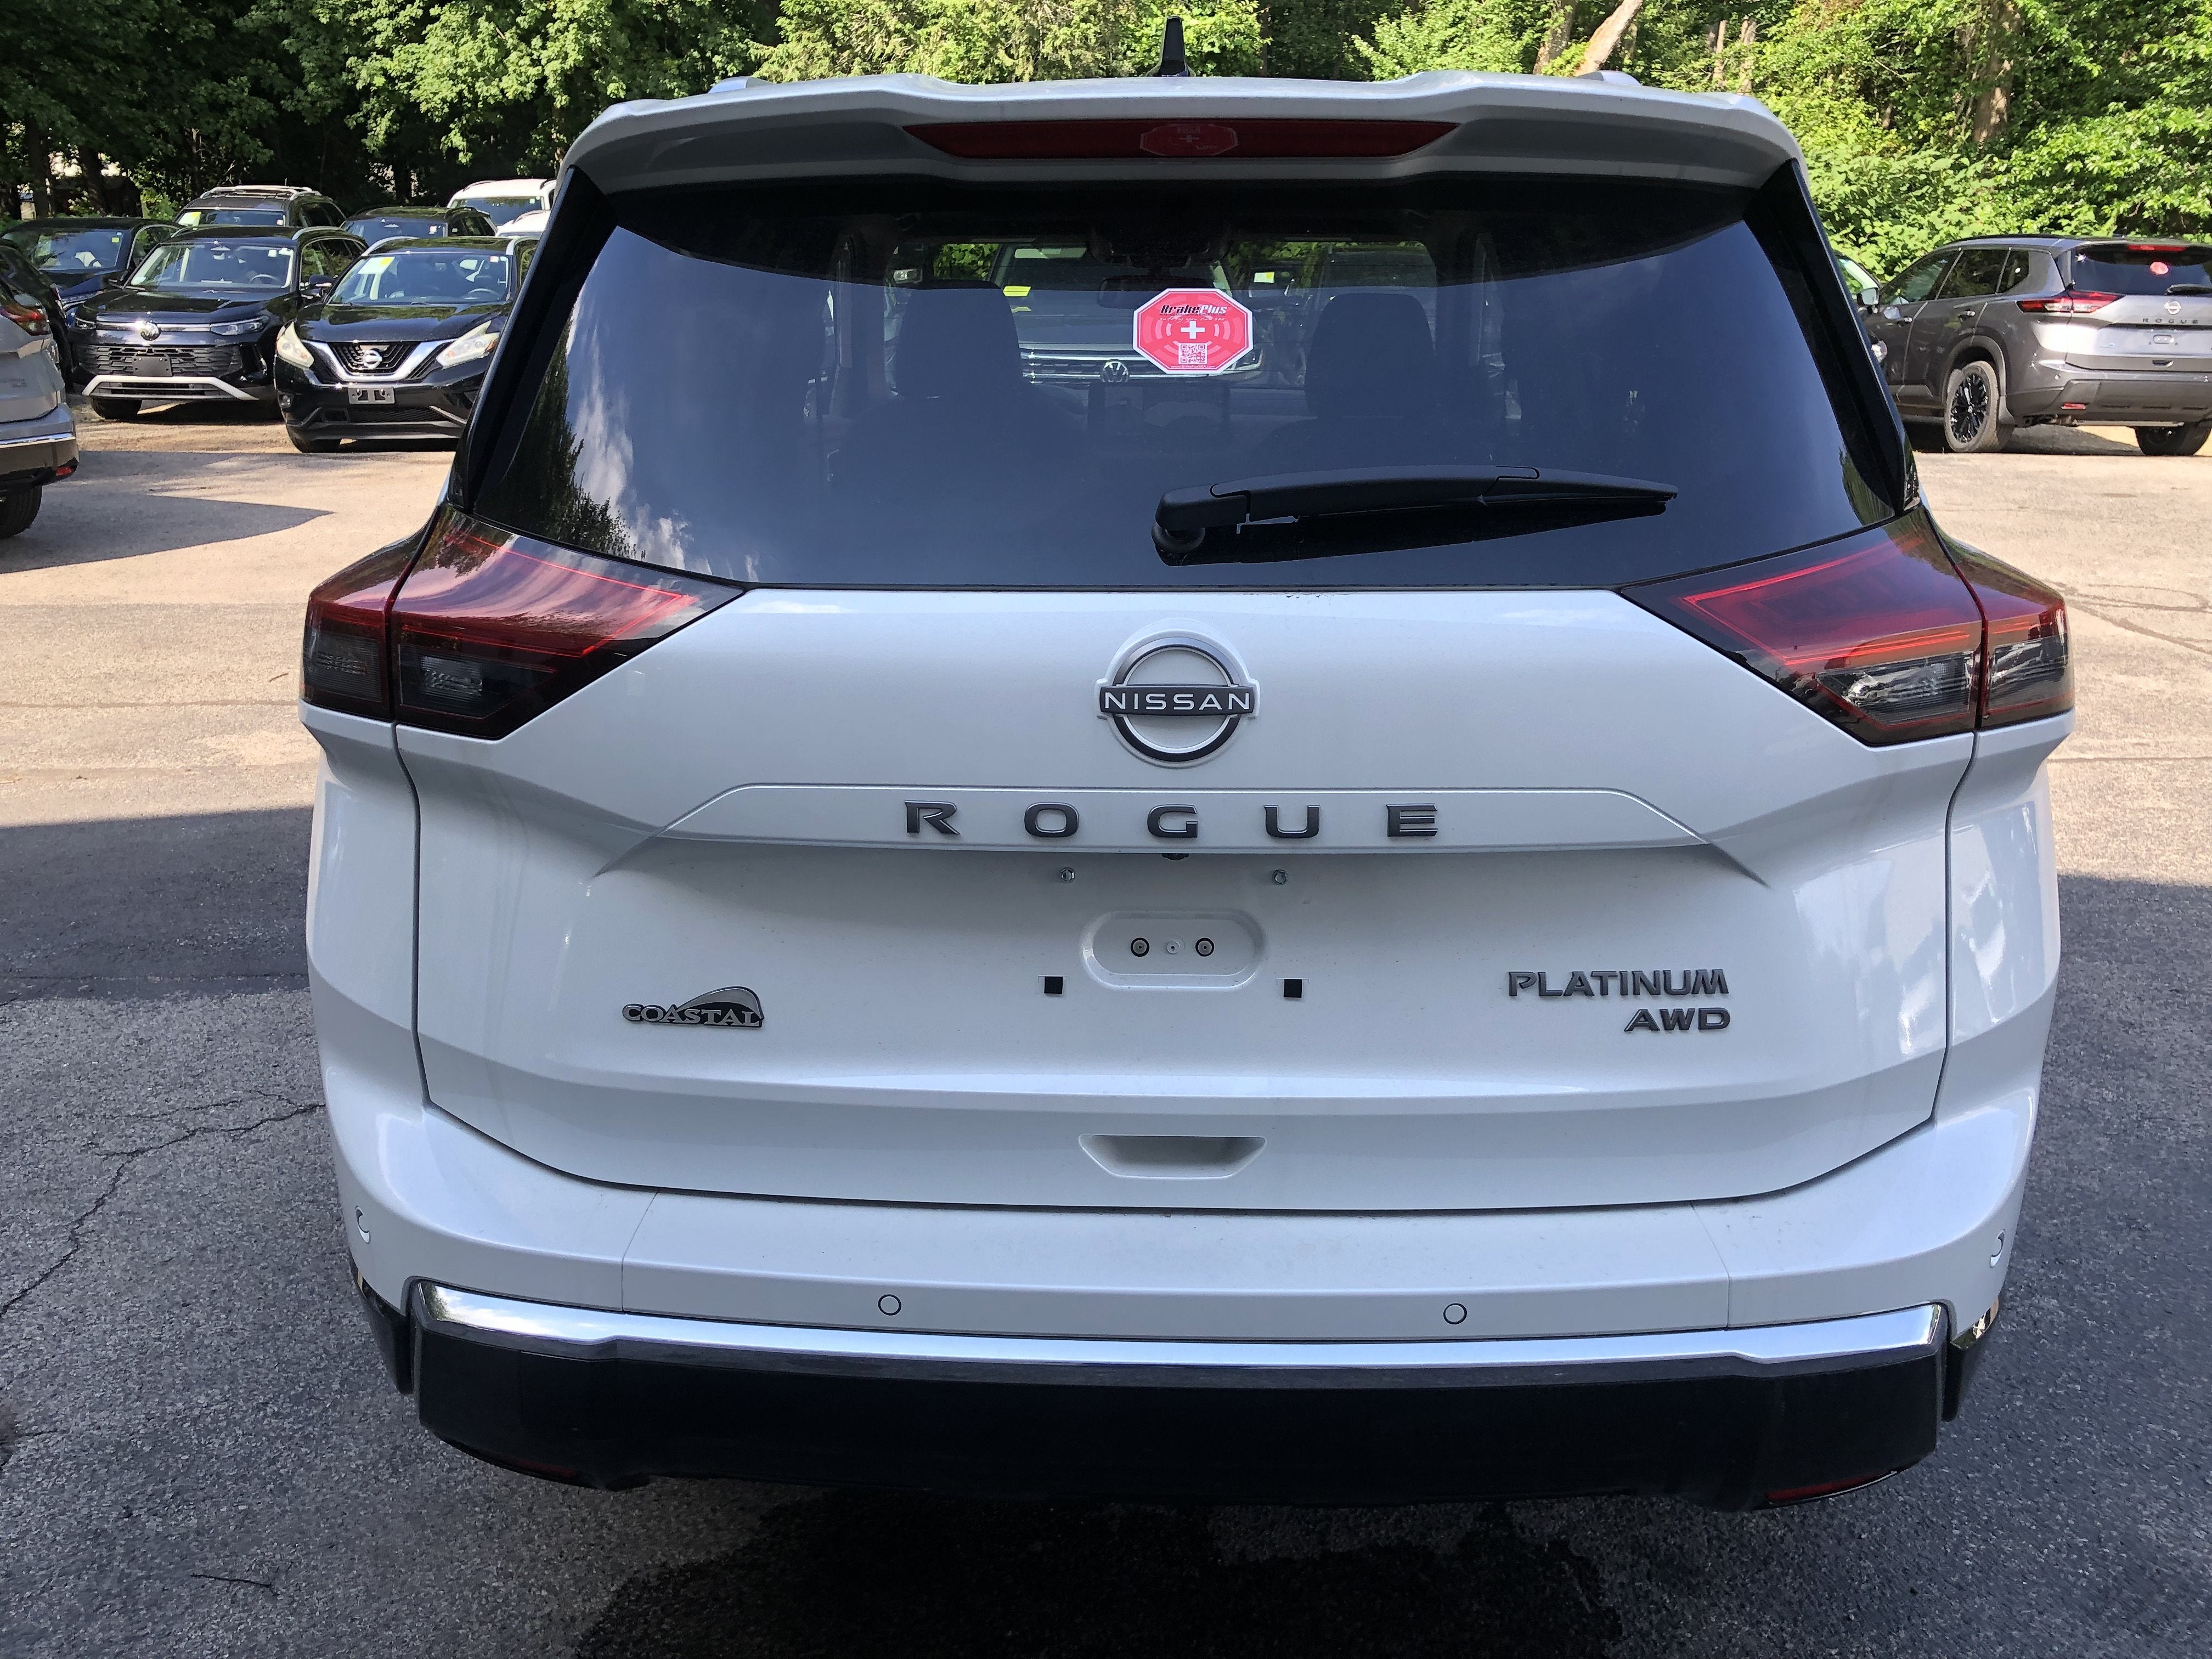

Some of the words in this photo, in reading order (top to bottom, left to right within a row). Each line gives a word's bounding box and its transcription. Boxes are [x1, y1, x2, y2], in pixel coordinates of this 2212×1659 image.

[1105, 692, 1250, 710] NISSAN
[904, 800, 1438, 839] ROGUE
[1508, 969, 1729, 996] PLATINUM
[622, 1003, 762, 1027] COASTAL
[1623, 1007, 1731, 1032] AWD
